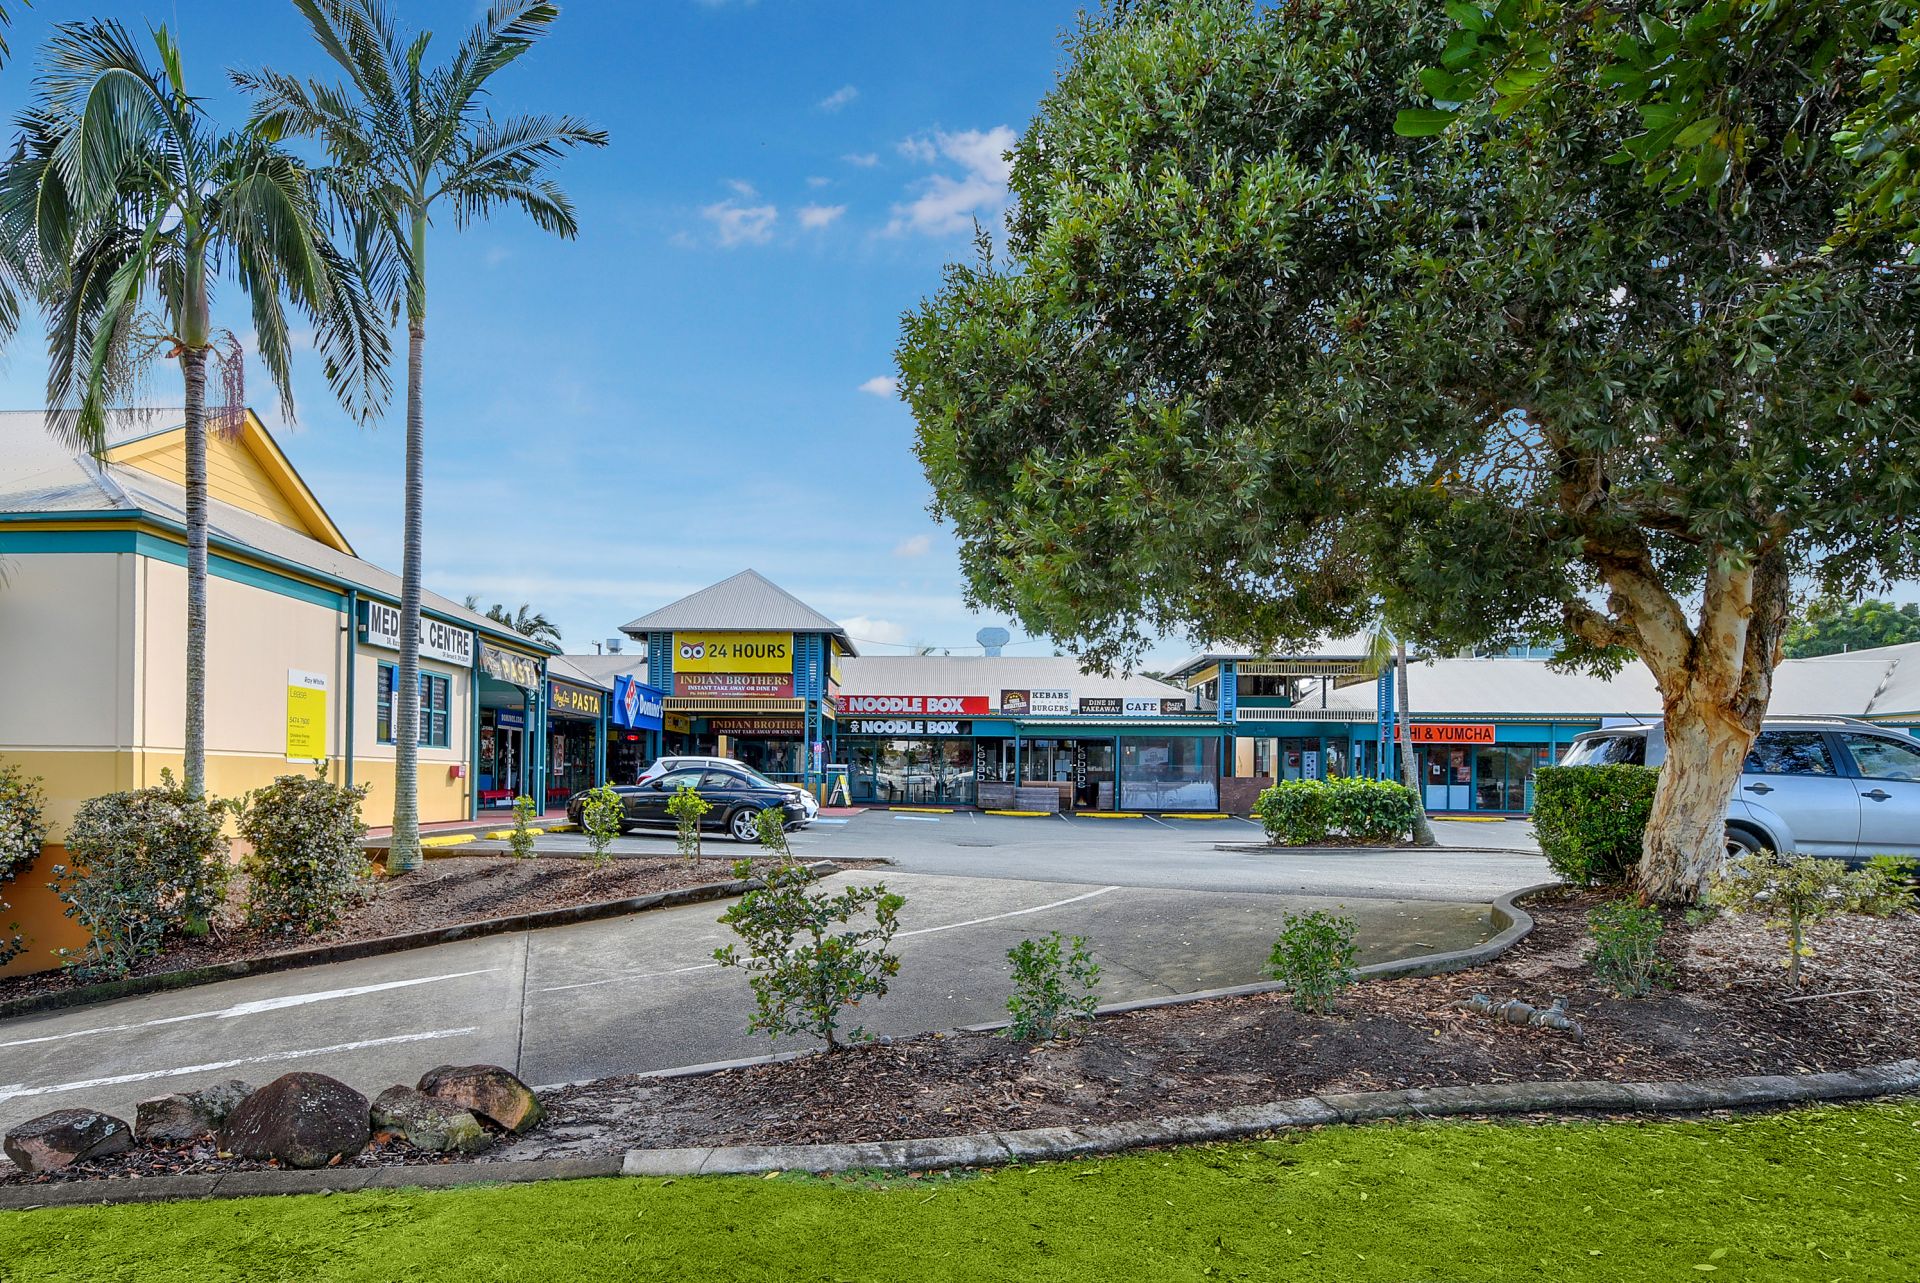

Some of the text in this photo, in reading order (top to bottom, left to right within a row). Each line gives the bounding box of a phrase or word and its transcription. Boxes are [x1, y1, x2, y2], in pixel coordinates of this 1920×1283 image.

[371, 604, 469, 656] MEDL CENTRE
[708, 643, 786, 659] 24 HOURS
[313, 677, 325, 686] White
[680, 675, 789, 686] INDIAN BROTHERS
[290, 688, 307, 699] Lease
[572, 691, 599, 714] PASTA
[640, 694, 663, 719] Domino's
[850, 697, 964, 712] NOODLE BOX
[1031, 704, 1069, 712] BURGERS
[1126, 703, 1157, 711] CAFE
[712, 720, 805, 729] INDIAN BROTHER
[861, 721, 959, 734] NOODLE BOX
[1424, 727, 1434, 740] &
[1437, 727, 1492, 740] YUMCHA
[977, 744, 986, 781] kebab
